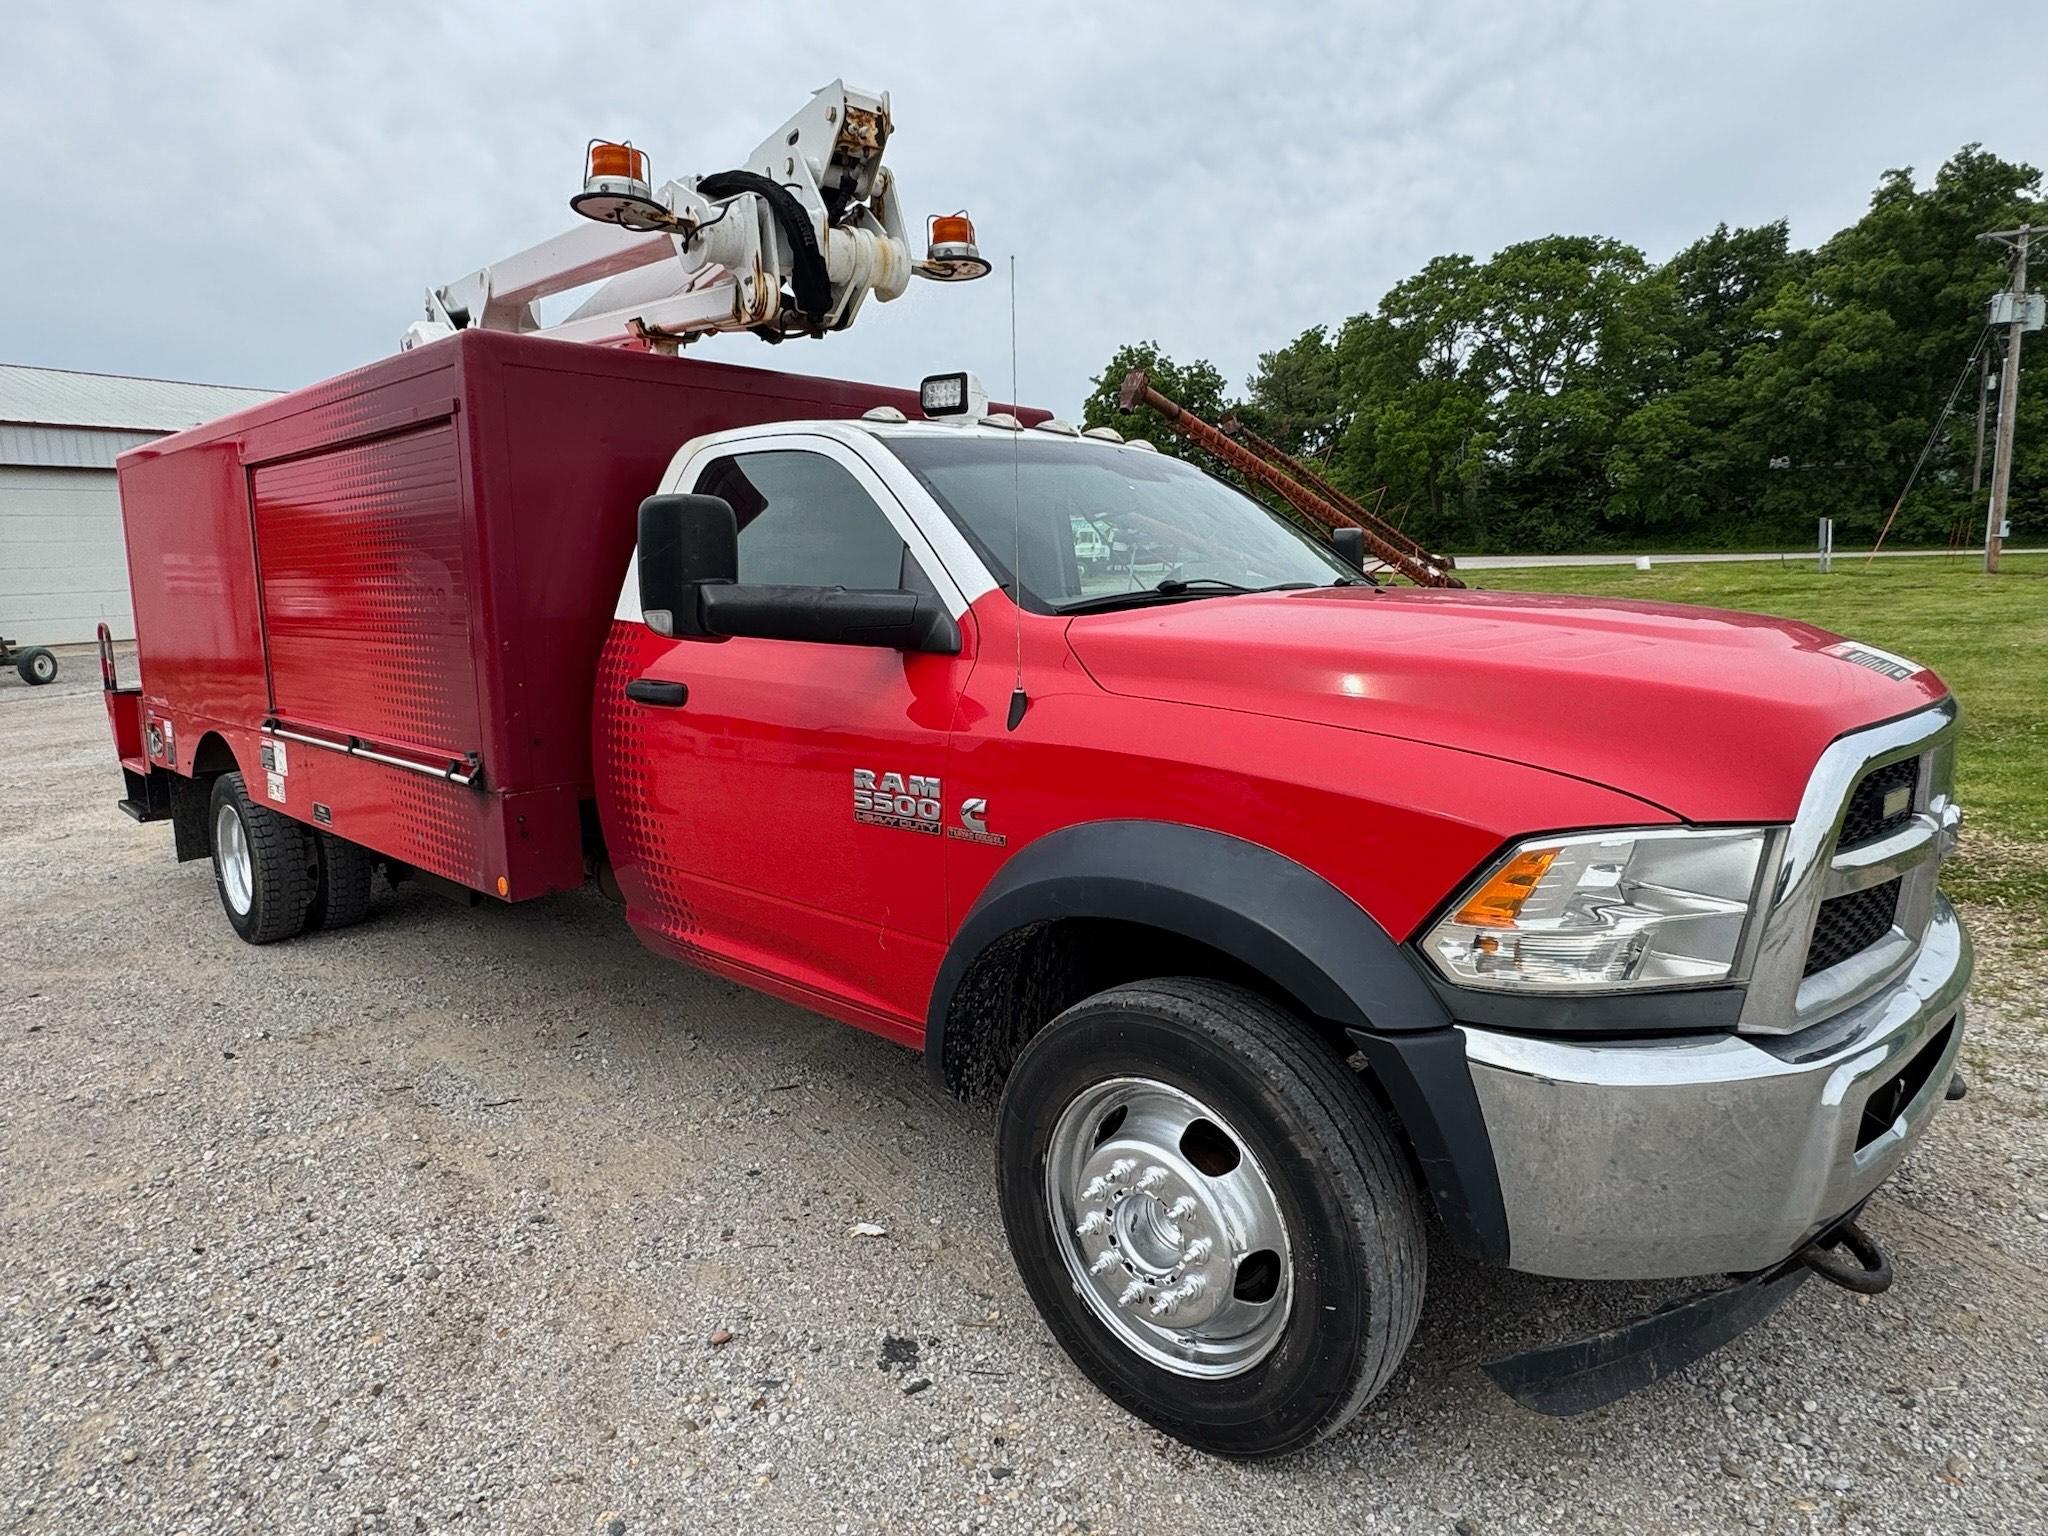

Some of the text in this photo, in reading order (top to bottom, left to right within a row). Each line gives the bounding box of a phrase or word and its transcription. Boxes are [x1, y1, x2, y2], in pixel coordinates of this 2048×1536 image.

[854, 768, 941, 798] RAM
[854, 789, 941, 821] 5500
[857, 811, 937, 833] HEAVY DUTY
